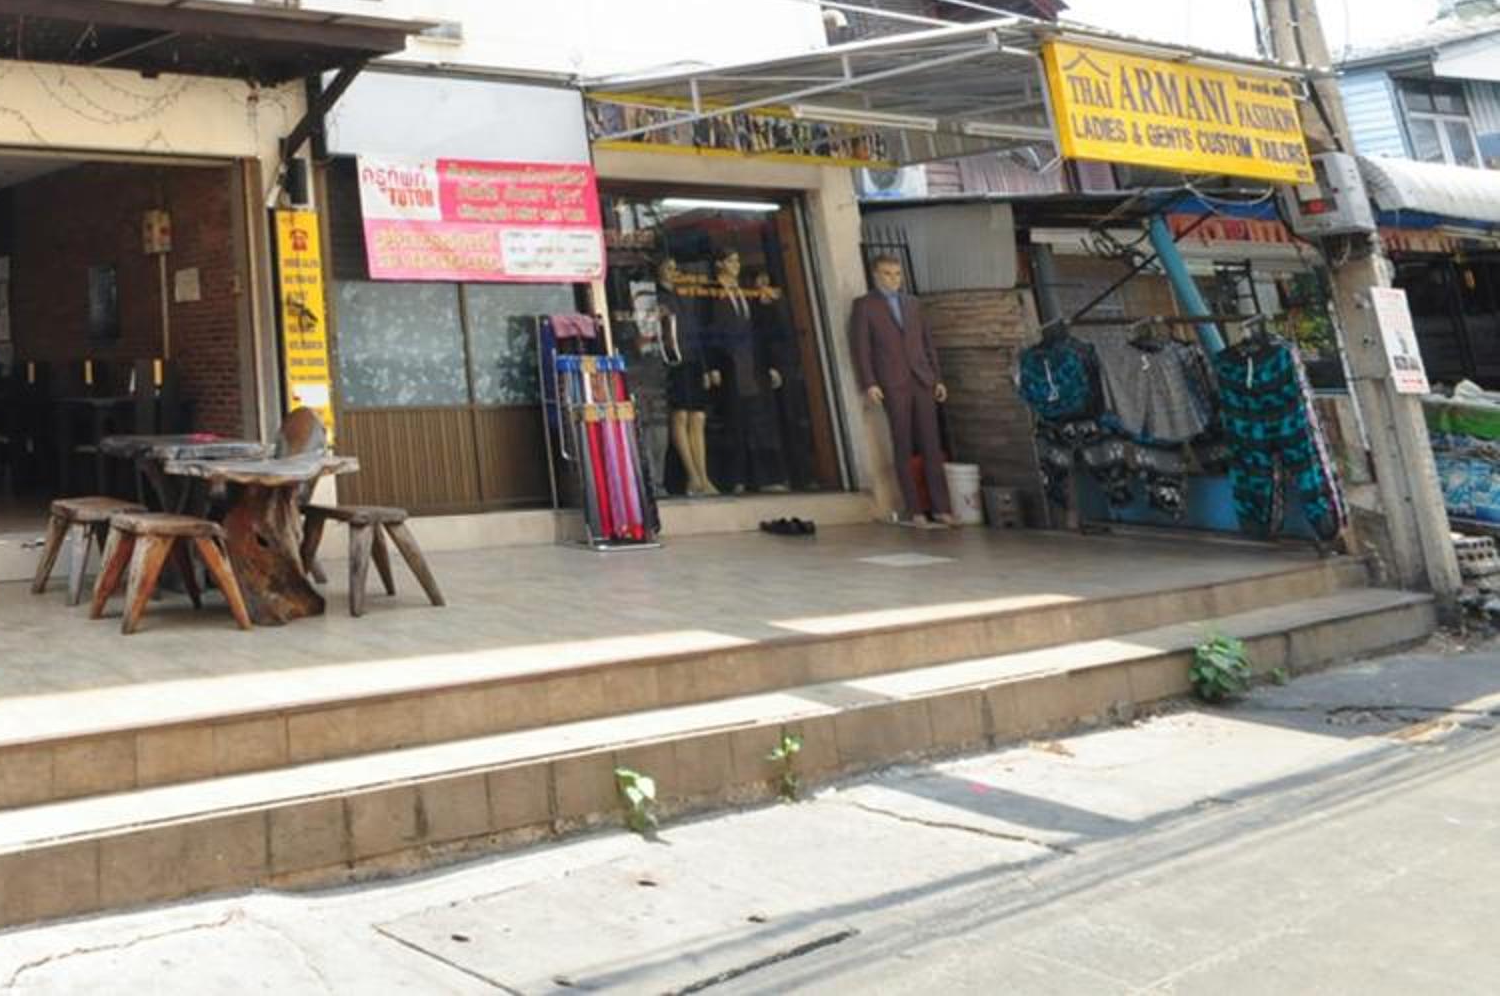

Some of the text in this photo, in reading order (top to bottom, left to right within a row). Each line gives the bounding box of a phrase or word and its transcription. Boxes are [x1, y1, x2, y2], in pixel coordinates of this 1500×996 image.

[1066, 74, 1114, 109] THAI
[1119, 65, 1232, 125] ARMANI
[1071, 112, 1128, 143] LADIES
